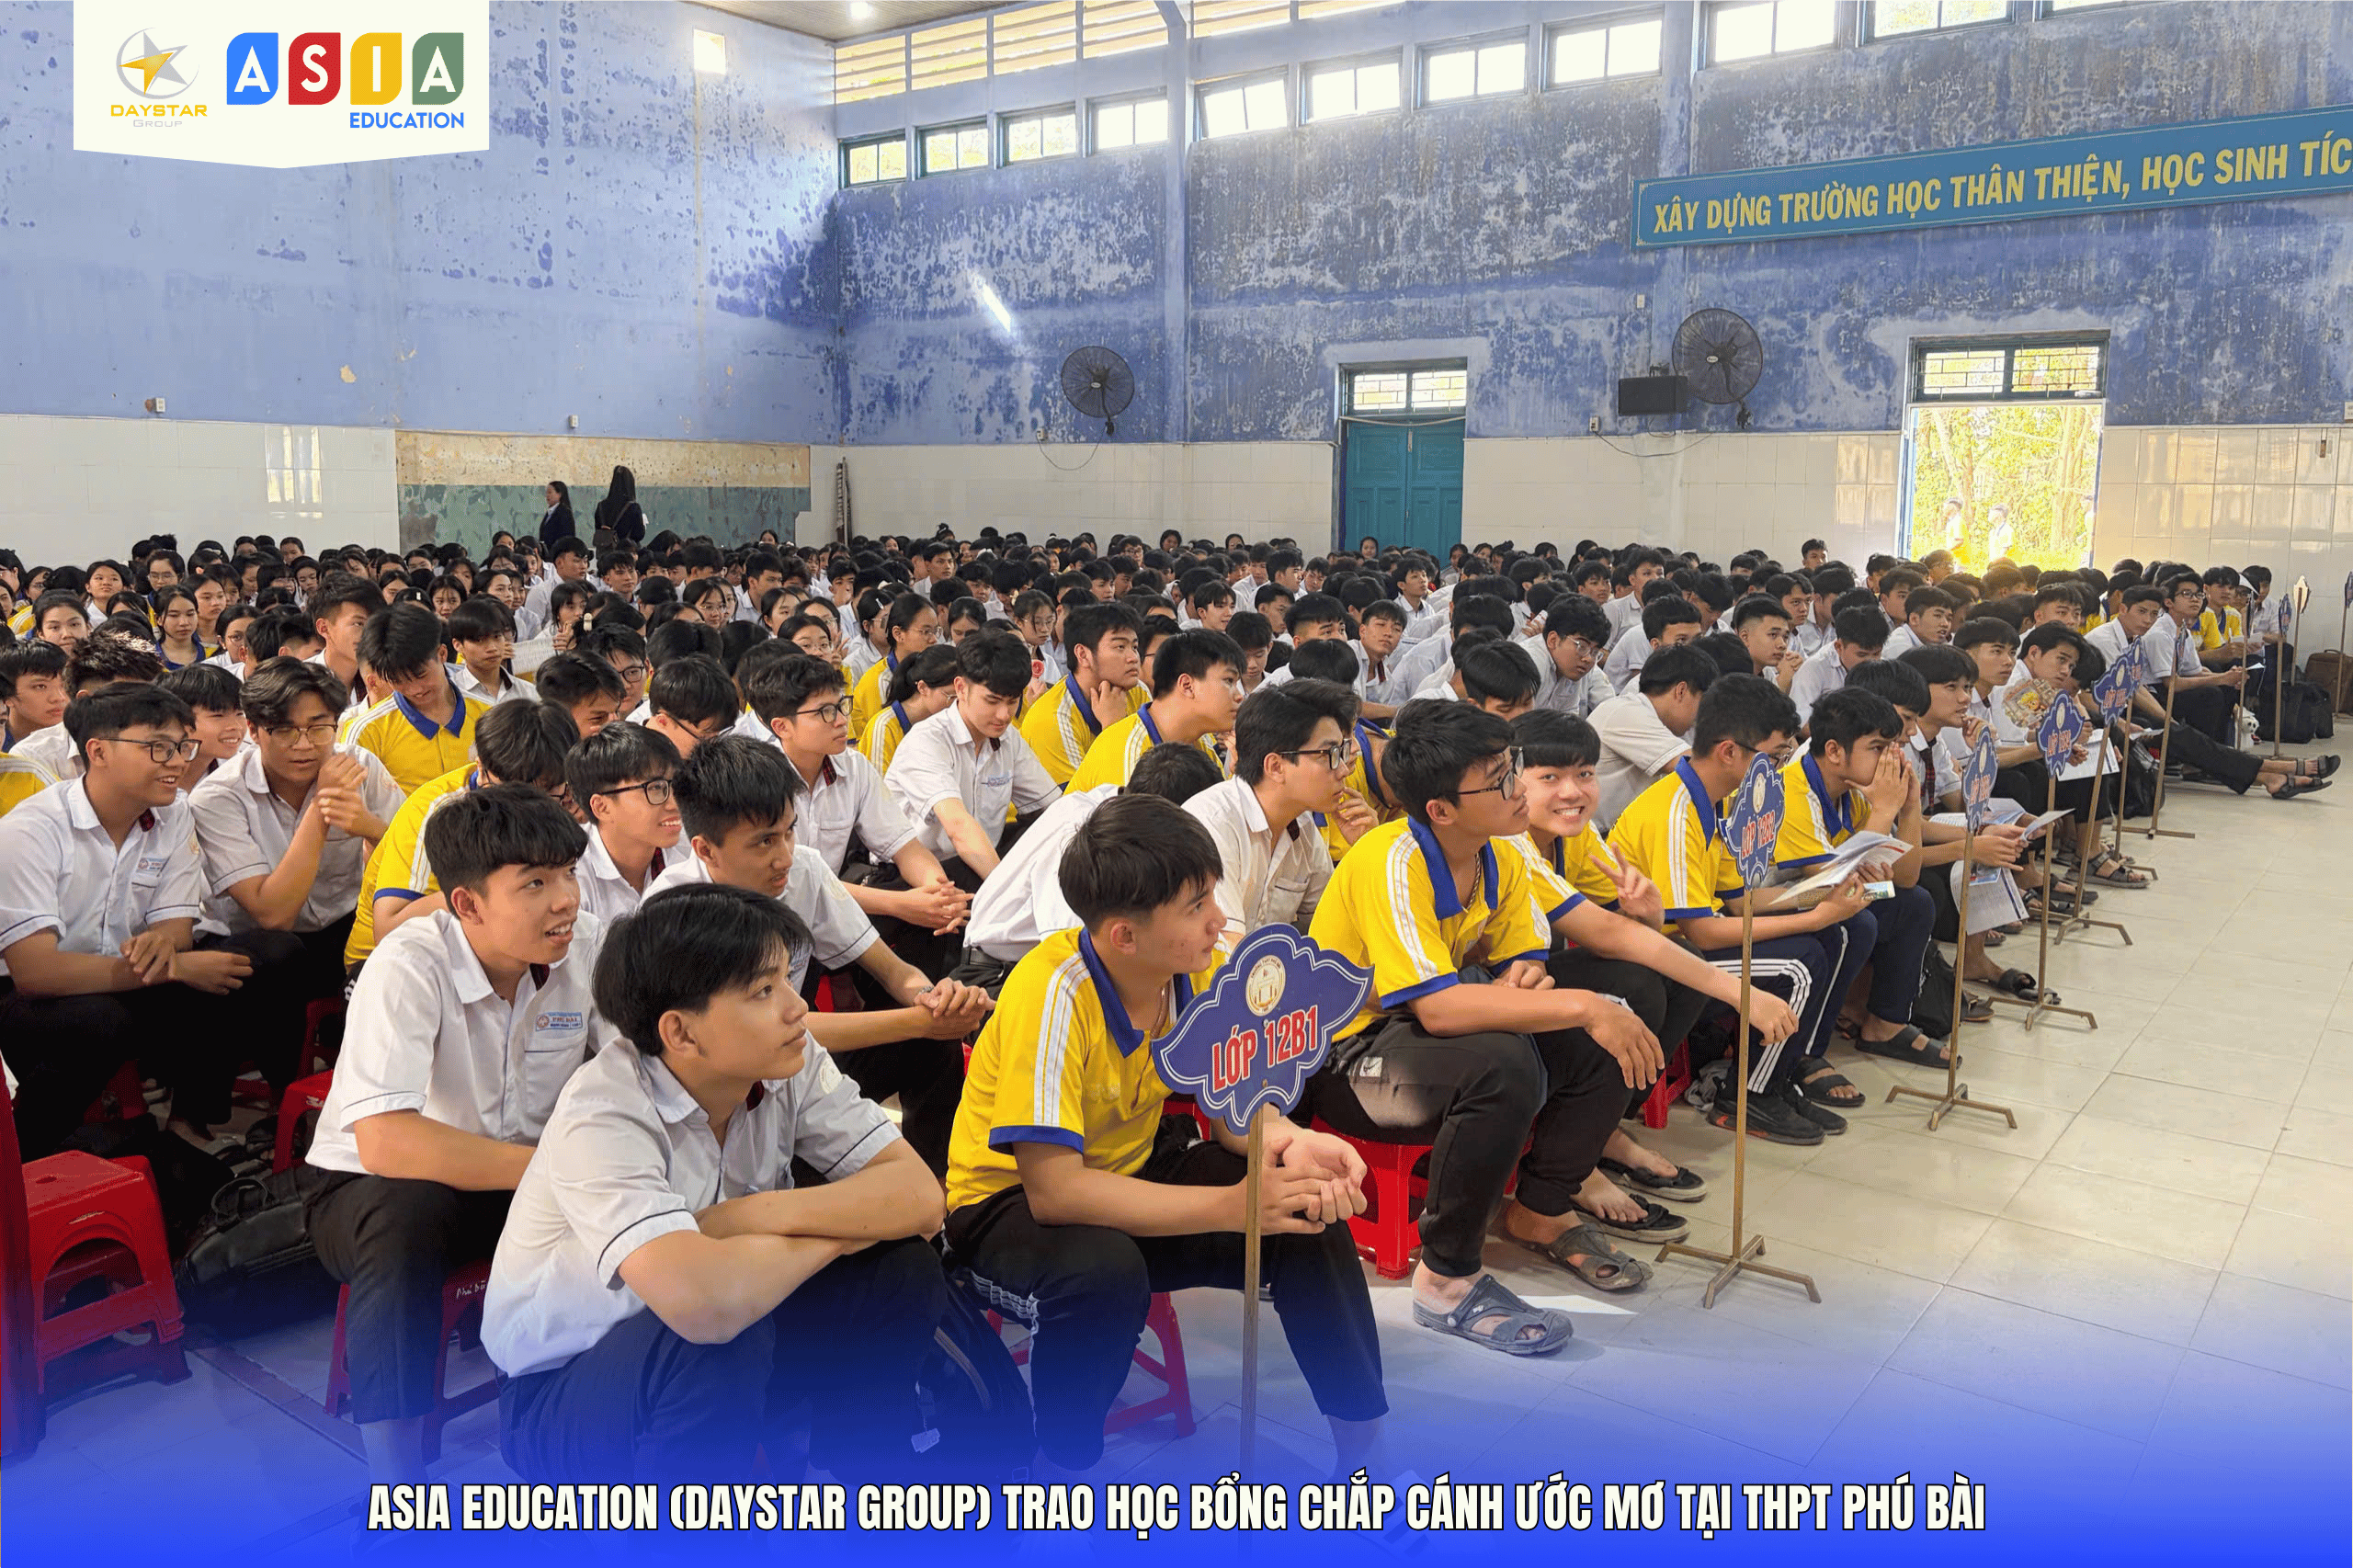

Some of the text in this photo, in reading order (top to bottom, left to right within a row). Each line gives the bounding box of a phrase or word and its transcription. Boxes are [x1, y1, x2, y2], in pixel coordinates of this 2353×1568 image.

[1654, 195, 1699, 233] XÂY
[1707, 191, 1772, 234] DỰNG
[1779, 180, 1878, 224] TRƯỜNG
[1887, 178, 1942, 219] HỌC
[1949, 164, 2025, 208] THÂN
[2034, 153, 2130, 203] THIỆN,
[2142, 151, 2205, 196] HỌC
[2213, 143, 2289, 185] SINH
[1741, 816, 1756, 860] LỚP
[1211, 1005, 1319, 1094] LỚP 12B1
